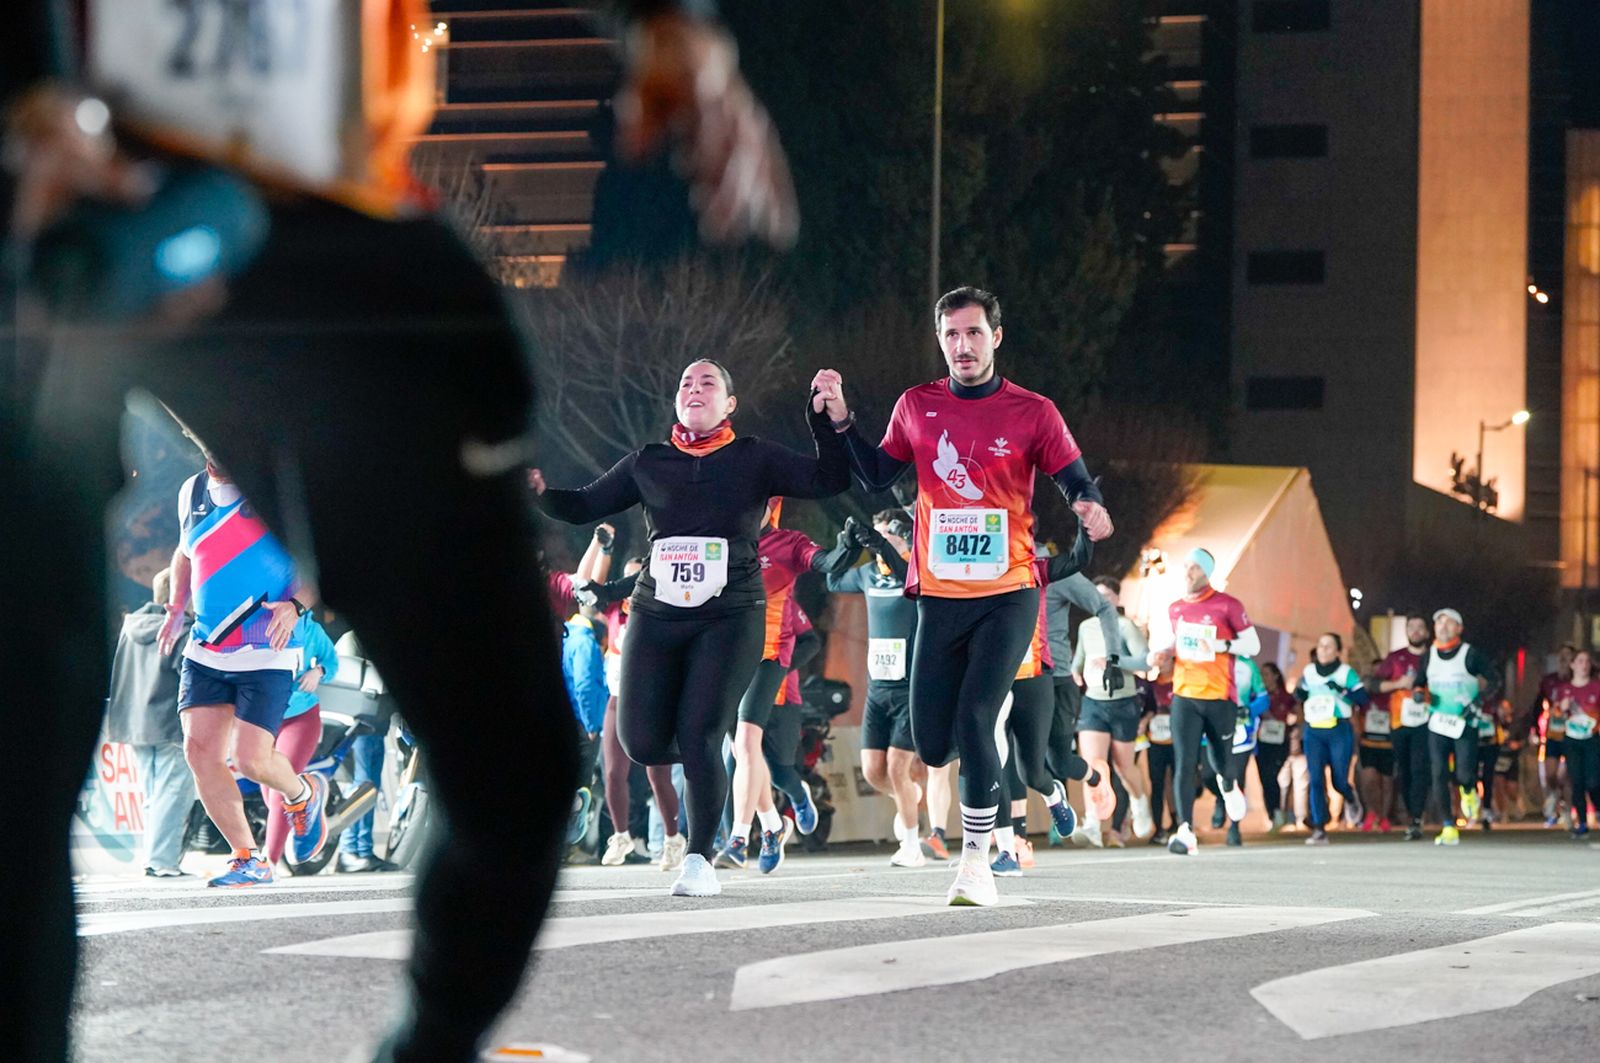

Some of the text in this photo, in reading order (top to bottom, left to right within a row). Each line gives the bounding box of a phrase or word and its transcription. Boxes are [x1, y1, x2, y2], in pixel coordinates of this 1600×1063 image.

[946, 468, 966, 489] 43
[939, 525, 953, 533] SAN
[954, 524, 978, 533] ANTÓN
[667, 544, 699, 552] NOCHE DE
[946, 534, 992, 556] 8472
[659, 552, 673, 561] SAN
[670, 562, 705, 583] 759
